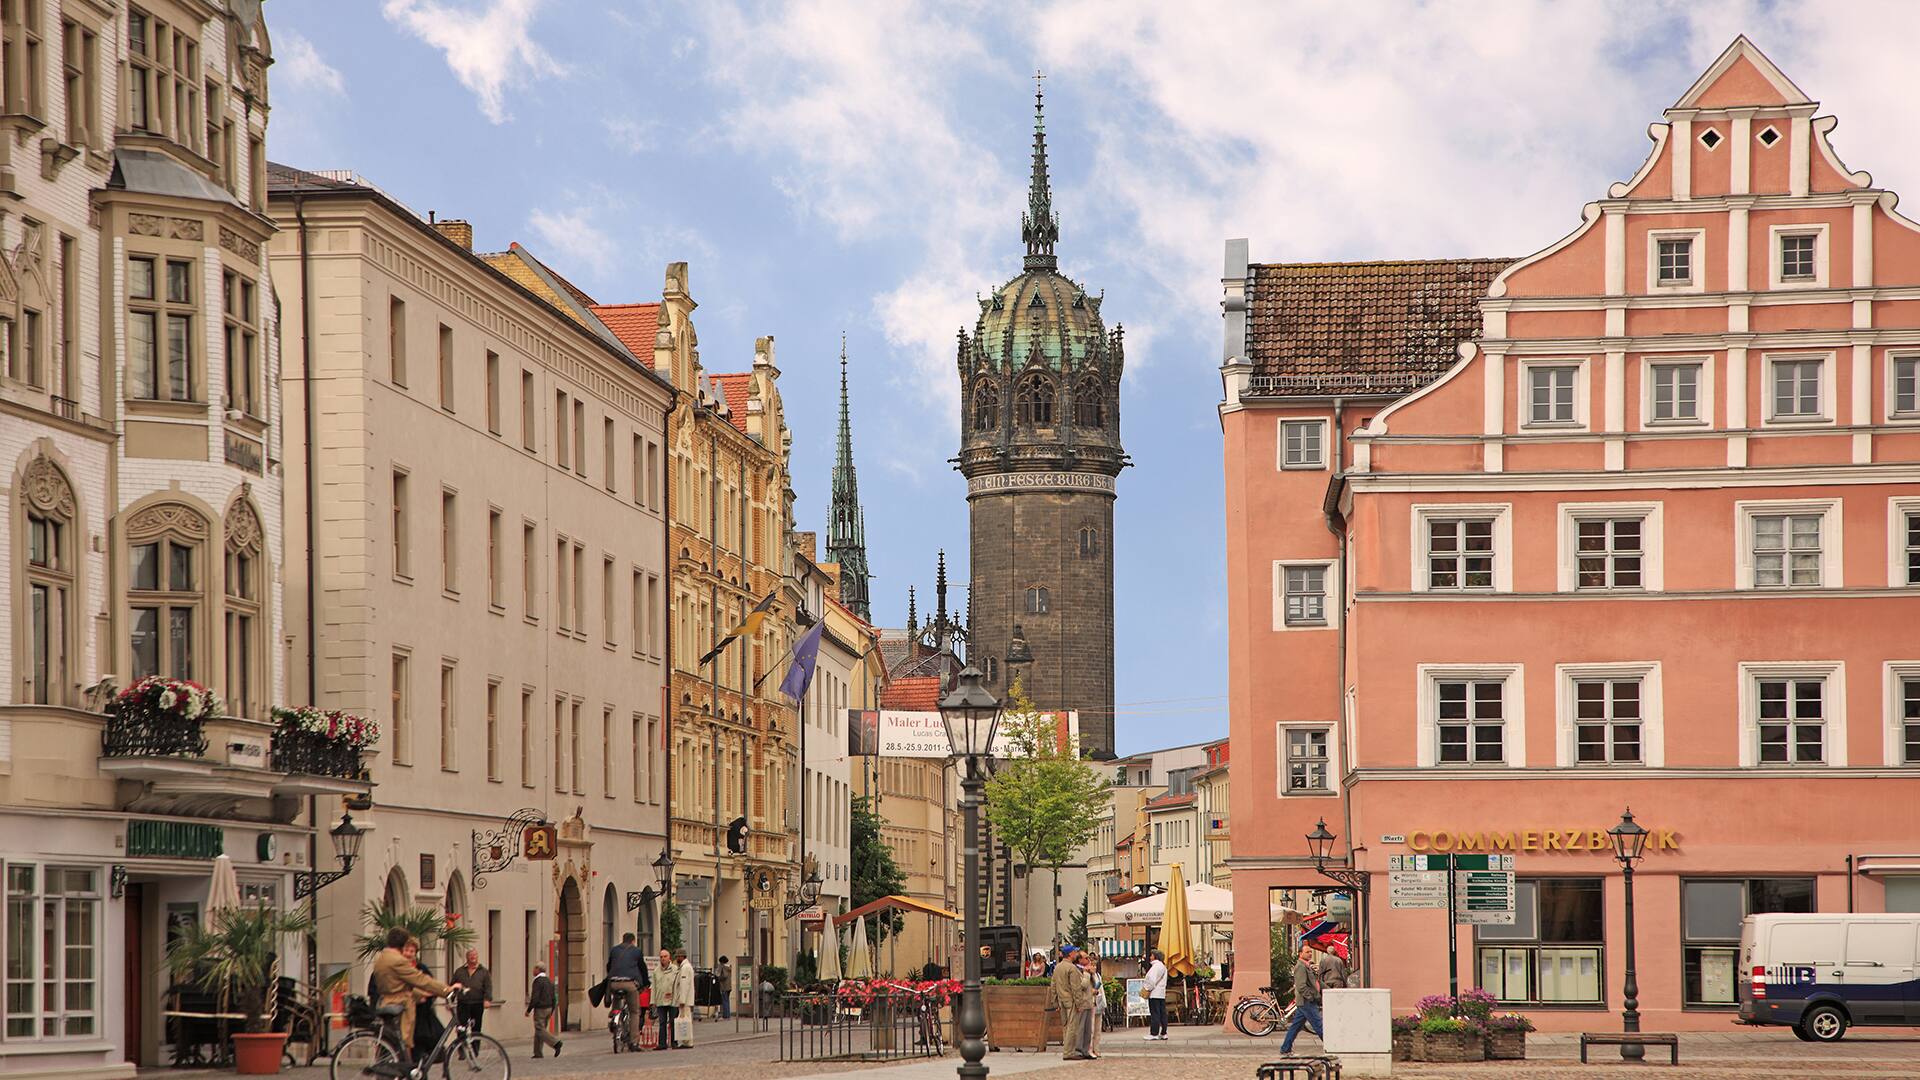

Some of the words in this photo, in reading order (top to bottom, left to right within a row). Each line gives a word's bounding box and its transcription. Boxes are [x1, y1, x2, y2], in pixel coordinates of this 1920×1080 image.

[985, 476, 1006, 488] EIN
[1056, 474, 1090, 487] BURG
[887, 717, 921, 728] Maler
[925, 717, 945, 728] Luc
[886, 742, 941, 752] 28.5.-25.9.2011
[527, 829, 551, 856] A
[1407, 830, 1679, 851] COMMERZBK
[754, 898, 773, 908] HOTEL
